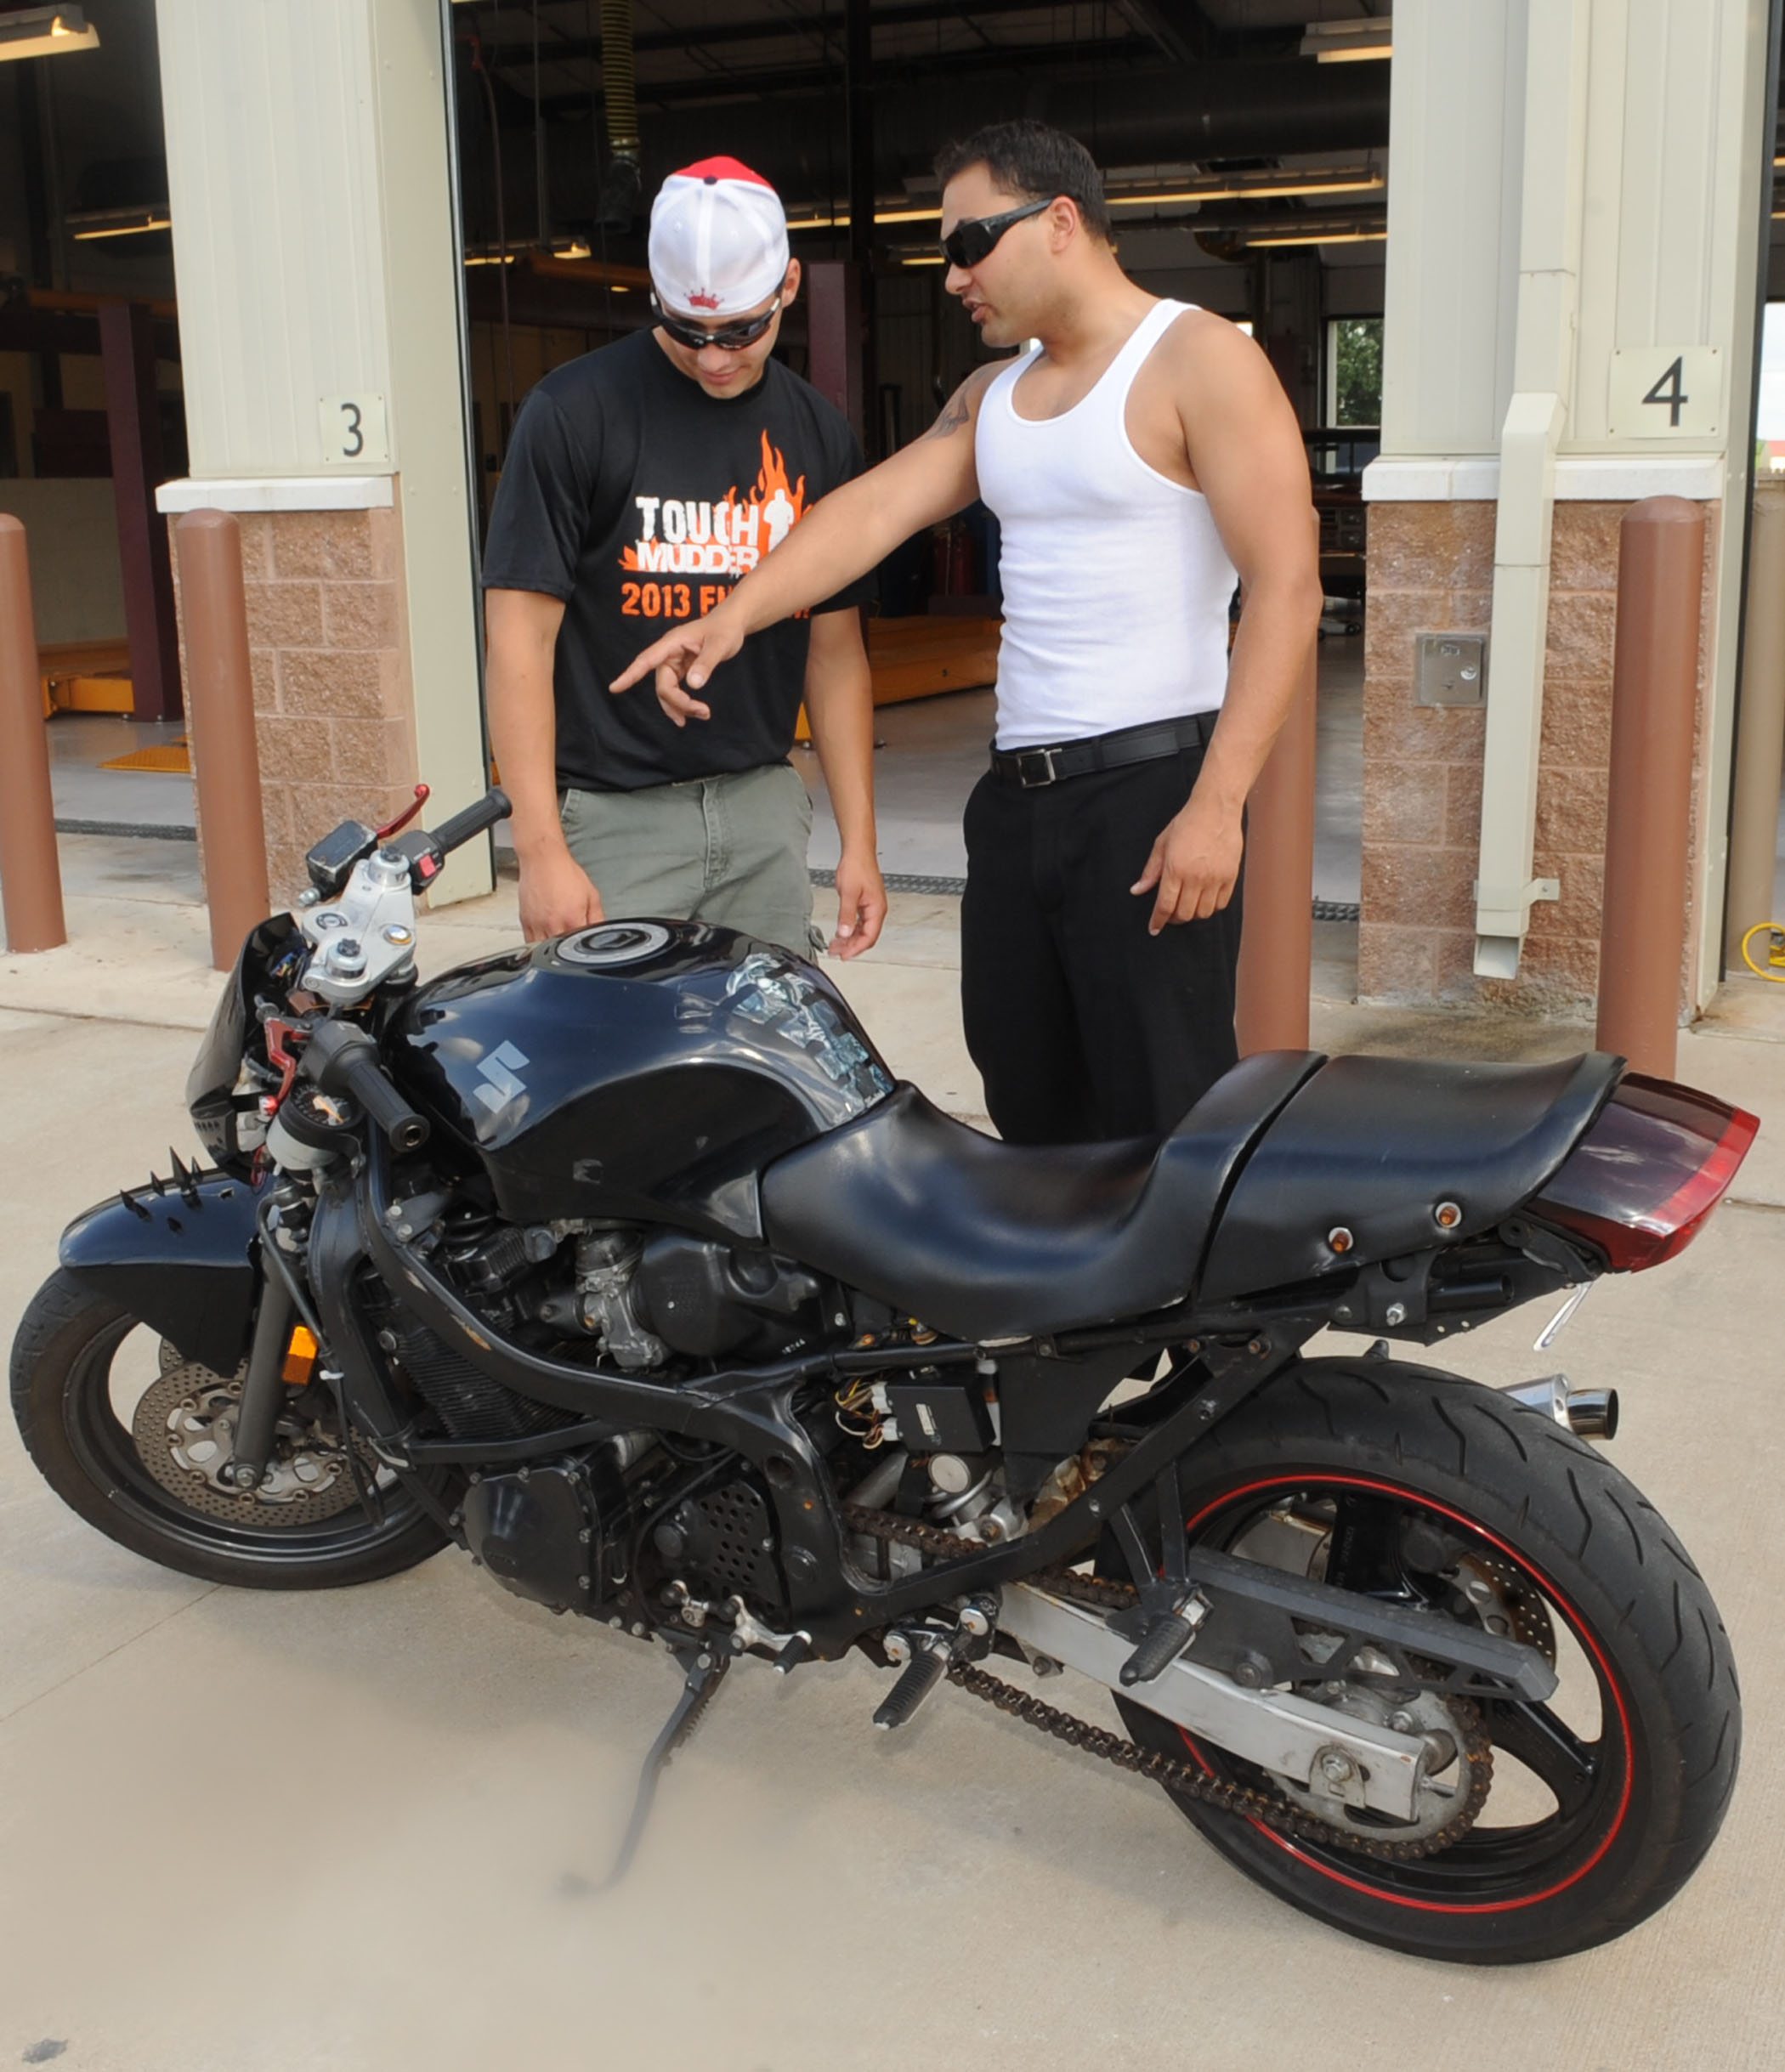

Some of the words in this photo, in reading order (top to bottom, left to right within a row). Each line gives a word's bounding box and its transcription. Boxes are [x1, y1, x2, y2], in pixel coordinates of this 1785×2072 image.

[1641, 355, 1688, 427] 4
[341, 402, 364, 457] 3
[621, 582, 691, 618] 2013
